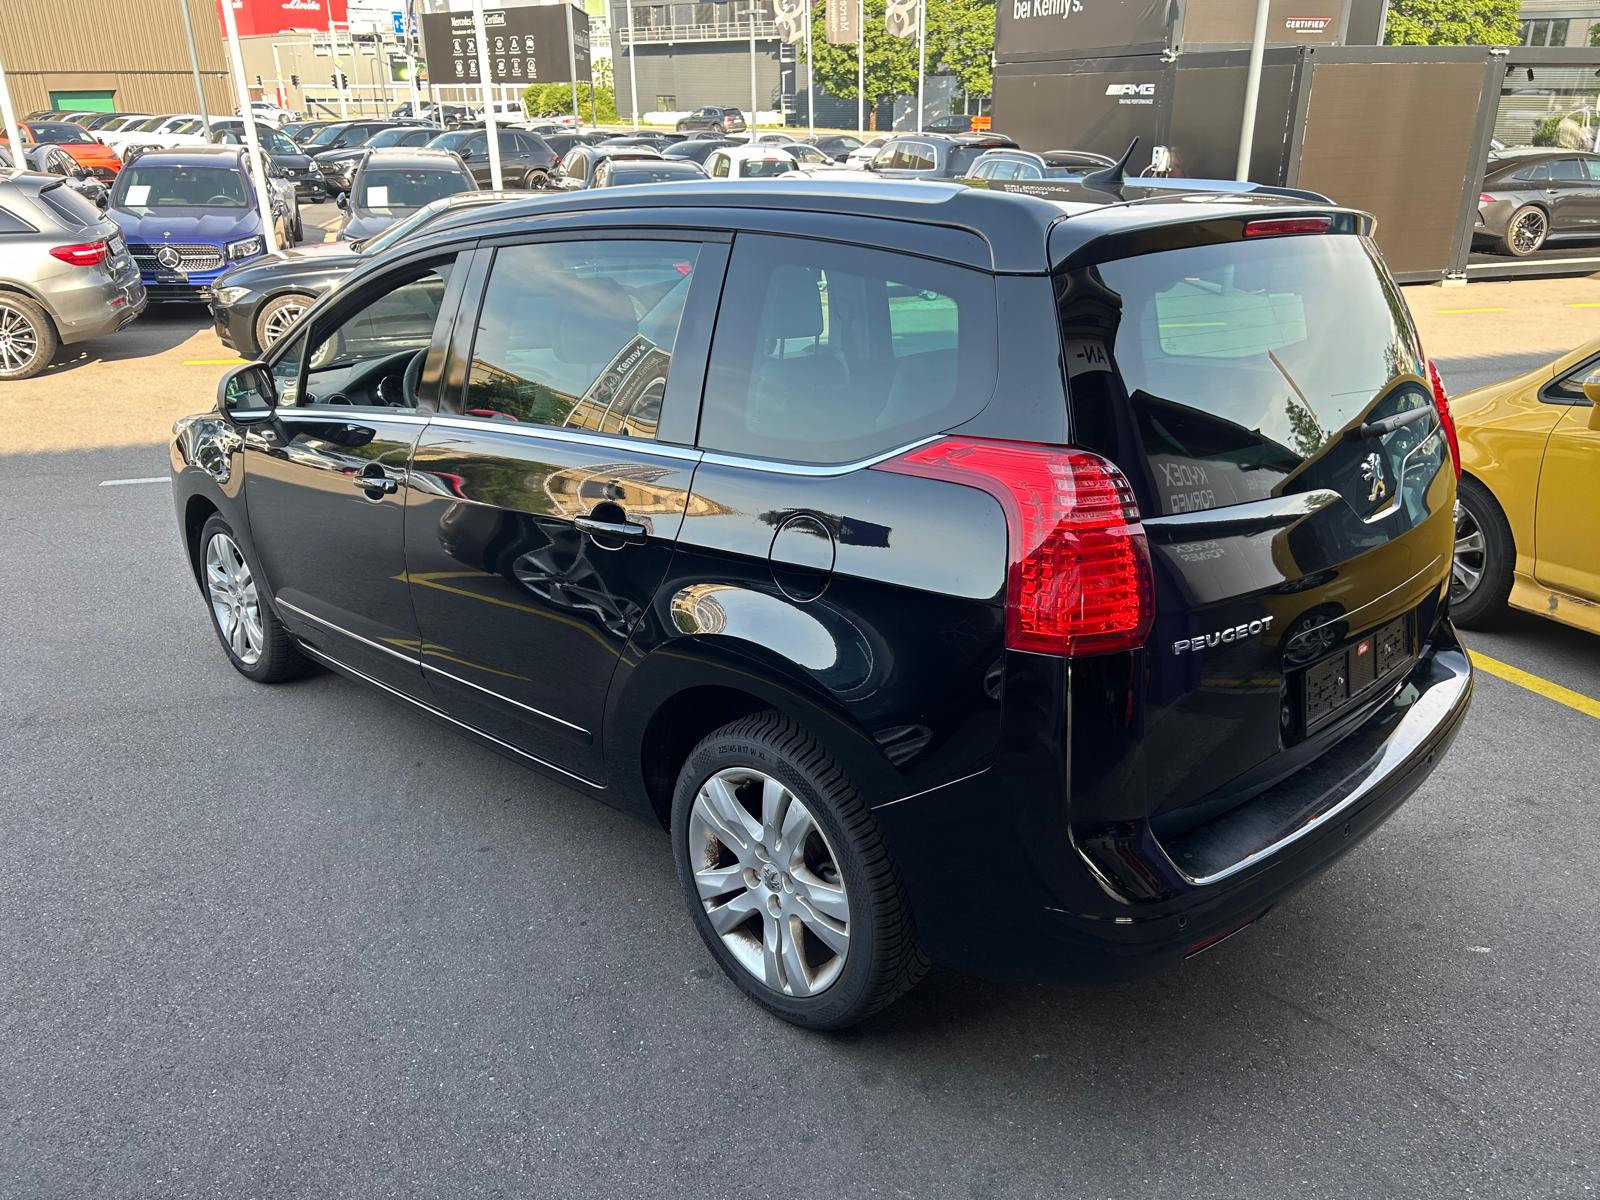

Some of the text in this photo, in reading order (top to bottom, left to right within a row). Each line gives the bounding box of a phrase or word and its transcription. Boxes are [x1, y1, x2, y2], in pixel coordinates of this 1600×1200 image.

[1033, 0, 1083, 19] Kennys.
[1286, 20, 1325, 28] CERTIFIED
[1121, 83, 1155, 95] AMG
[616, 344, 646, 374] Kenny's
[1172, 615, 1274, 656] PEUGEOT
